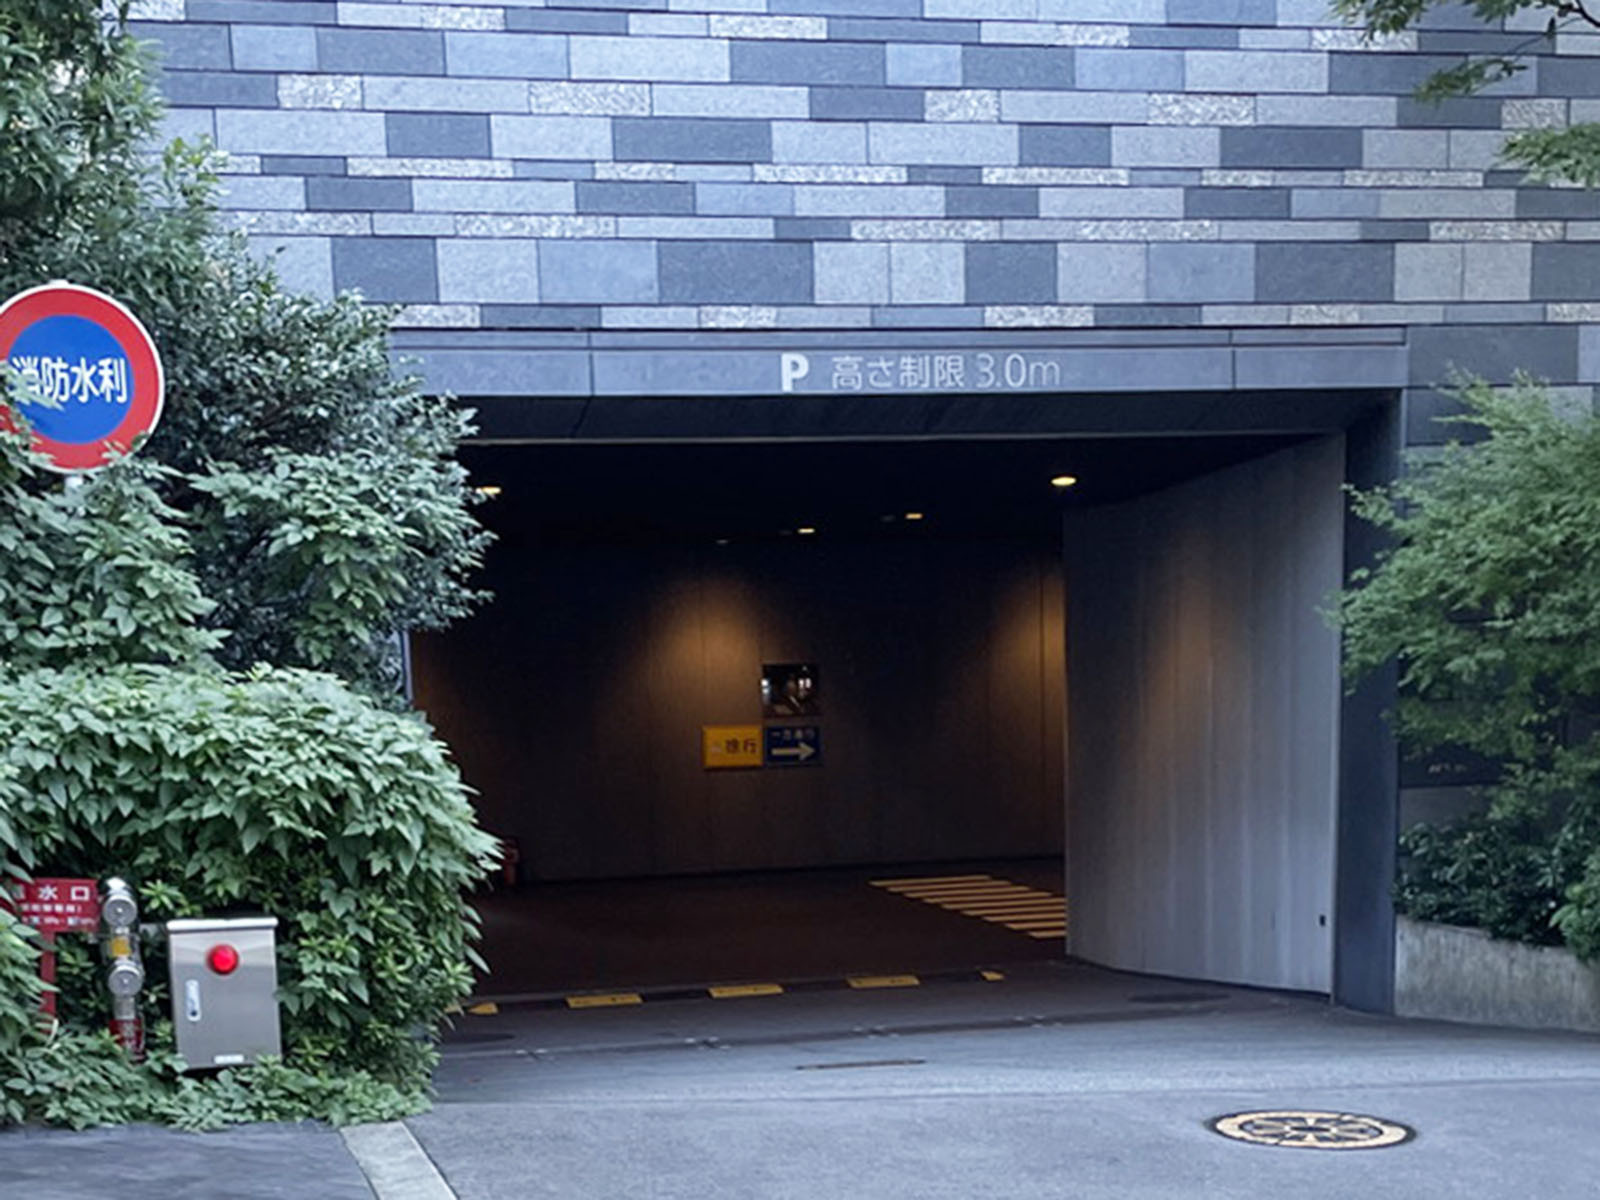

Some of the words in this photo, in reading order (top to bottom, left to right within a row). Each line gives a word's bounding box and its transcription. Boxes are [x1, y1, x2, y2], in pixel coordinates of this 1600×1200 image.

[780, 353, 809, 392] P
[831, 354, 965, 390] 高さ制限
[975, 352, 1061, 388] 3.0m
